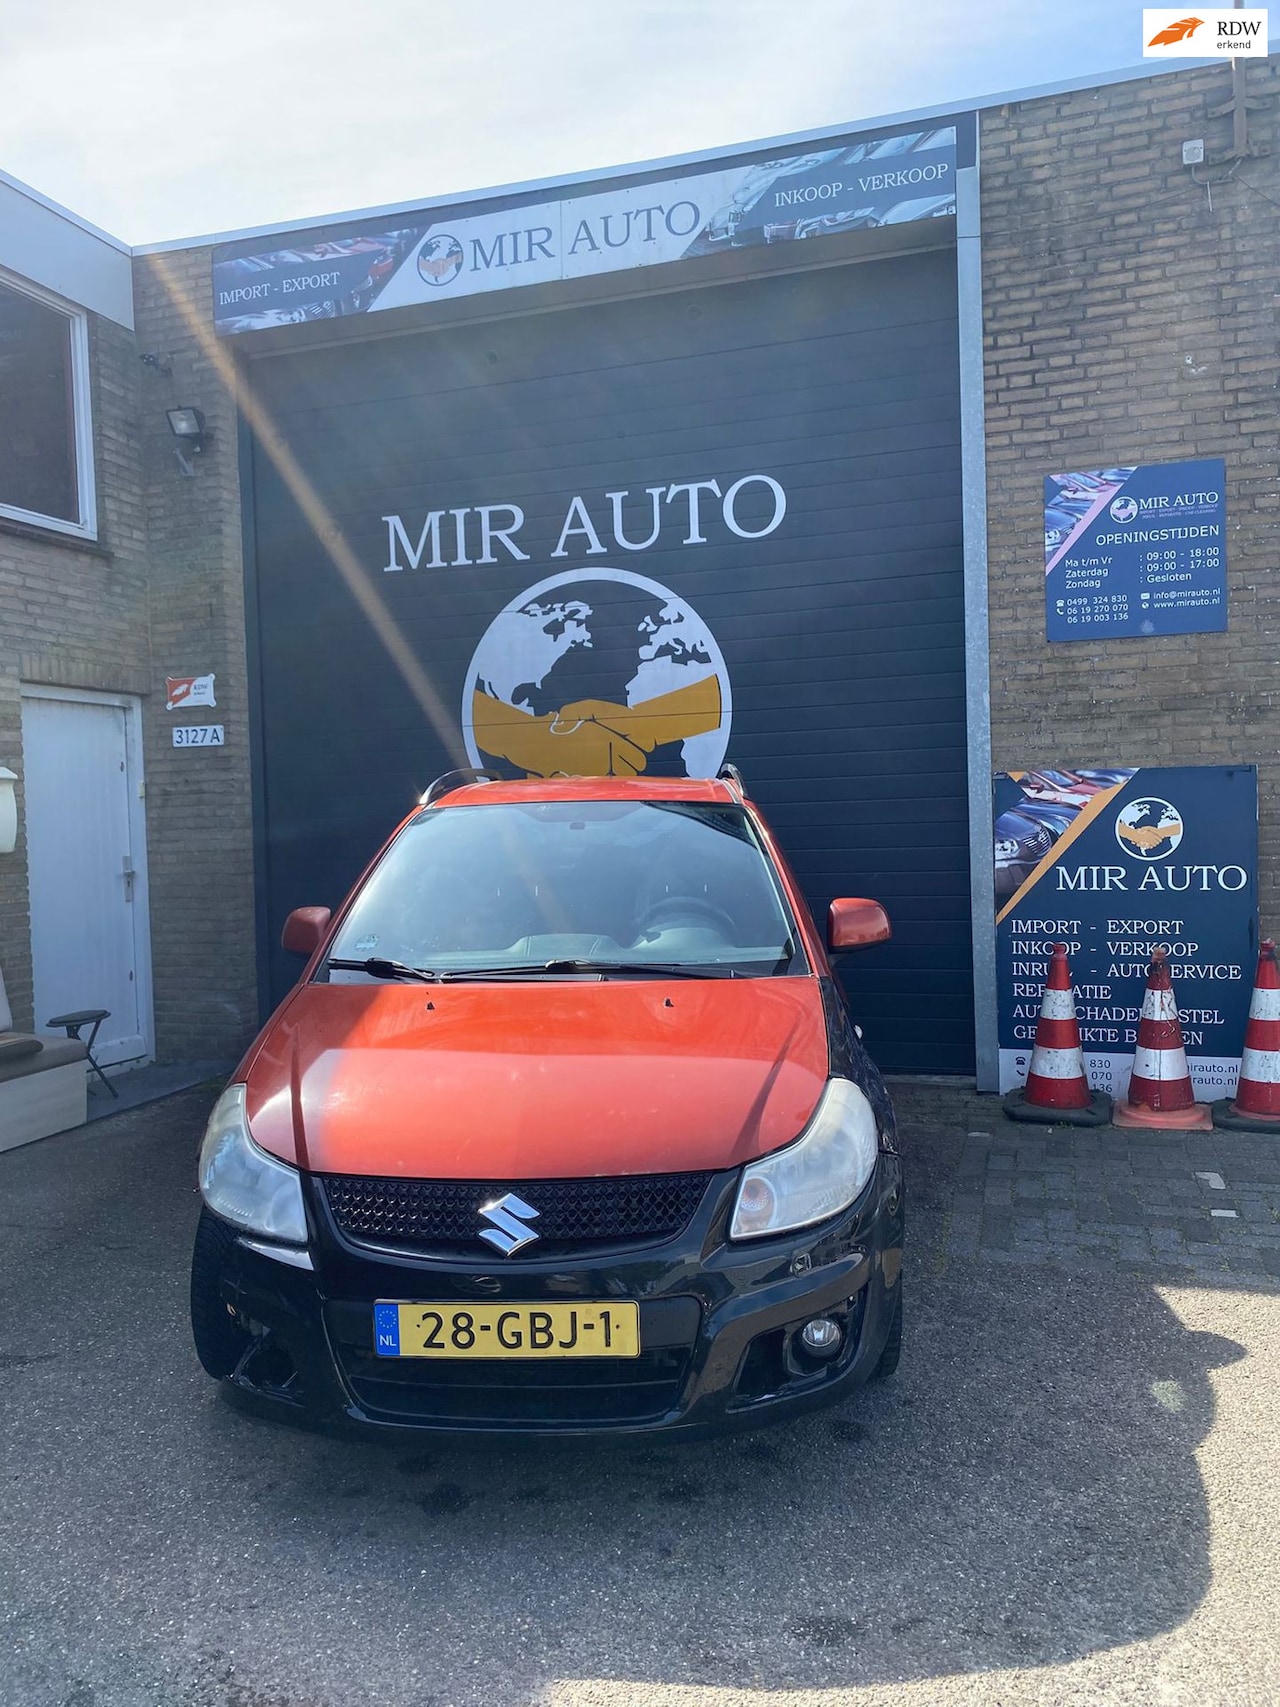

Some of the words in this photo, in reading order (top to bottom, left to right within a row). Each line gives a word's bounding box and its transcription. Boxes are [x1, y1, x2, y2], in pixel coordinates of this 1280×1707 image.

[774, 182, 843, 207] INKOOP
[858, 163, 948, 192] VERKOOP
[469, 226, 556, 272] MIR
[567, 201, 701, 255] AUTO
[219, 283, 271, 305] IMPORT
[282, 271, 341, 293] EXPORT
[1139, 496, 1170, 510] MIR
[1173, 491, 1219, 507] AUTO
[382, 504, 531, 572] MIR
[551, 474, 787, 558] AUTO
[1095, 524, 1219, 546] OPENINGSTIJDEN
[1065, 559, 1079, 567] Ma
[1081, 557, 1099, 567] t/m
[1101, 556, 1113, 564] Vr
[1146, 550, 1177, 561] 09:00
[1189, 547, 1219, 558] 18:00
[1065, 568, 1109, 578] Zaterdag
[1146, 561, 1177, 572] 09:00
[1189, 558, 1220, 569] 17:00
[1065, 579, 1101, 589] Zondag
[1146, 573, 1192, 583] Gesloten
[1066, 597, 1088, 606] 0499
[1092, 596, 1108, 605] 324
[1111, 594, 1128, 603] 830
[1153, 587, 1221, 600] info@mirauto.nl
[1066, 607, 1078, 615] 06
[1081, 606, 1091, 614] 19
[1094, 604, 1110, 613] 270
[1112, 603, 1129, 612] 070
[1153, 597, 1220, 609] www.mirauto.nl
[1067, 616, 1078, 624] 06
[1081, 615, 1092, 623] 19
[1094, 613, 1110, 622] 003
[1113, 612, 1129, 621] 136
[175, 728, 208, 744] 3127
[1056, 866, 1128, 891] MIR
[1138, 865, 1248, 891] AUTO
[1011, 920, 1082, 934] IMPORT
[1107, 920, 1184, 935] EXPORT
[1107, 941, 1199, 957] VERKOOP
[1013, 983, 1112, 999] REPATIE
[1090, 1059, 1110, 1068] 830
[1091, 1071, 1112, 1080] 070
[380, 1334, 397, 1347] NL
[422, 1311, 611, 1349] 28-GBJ-1
